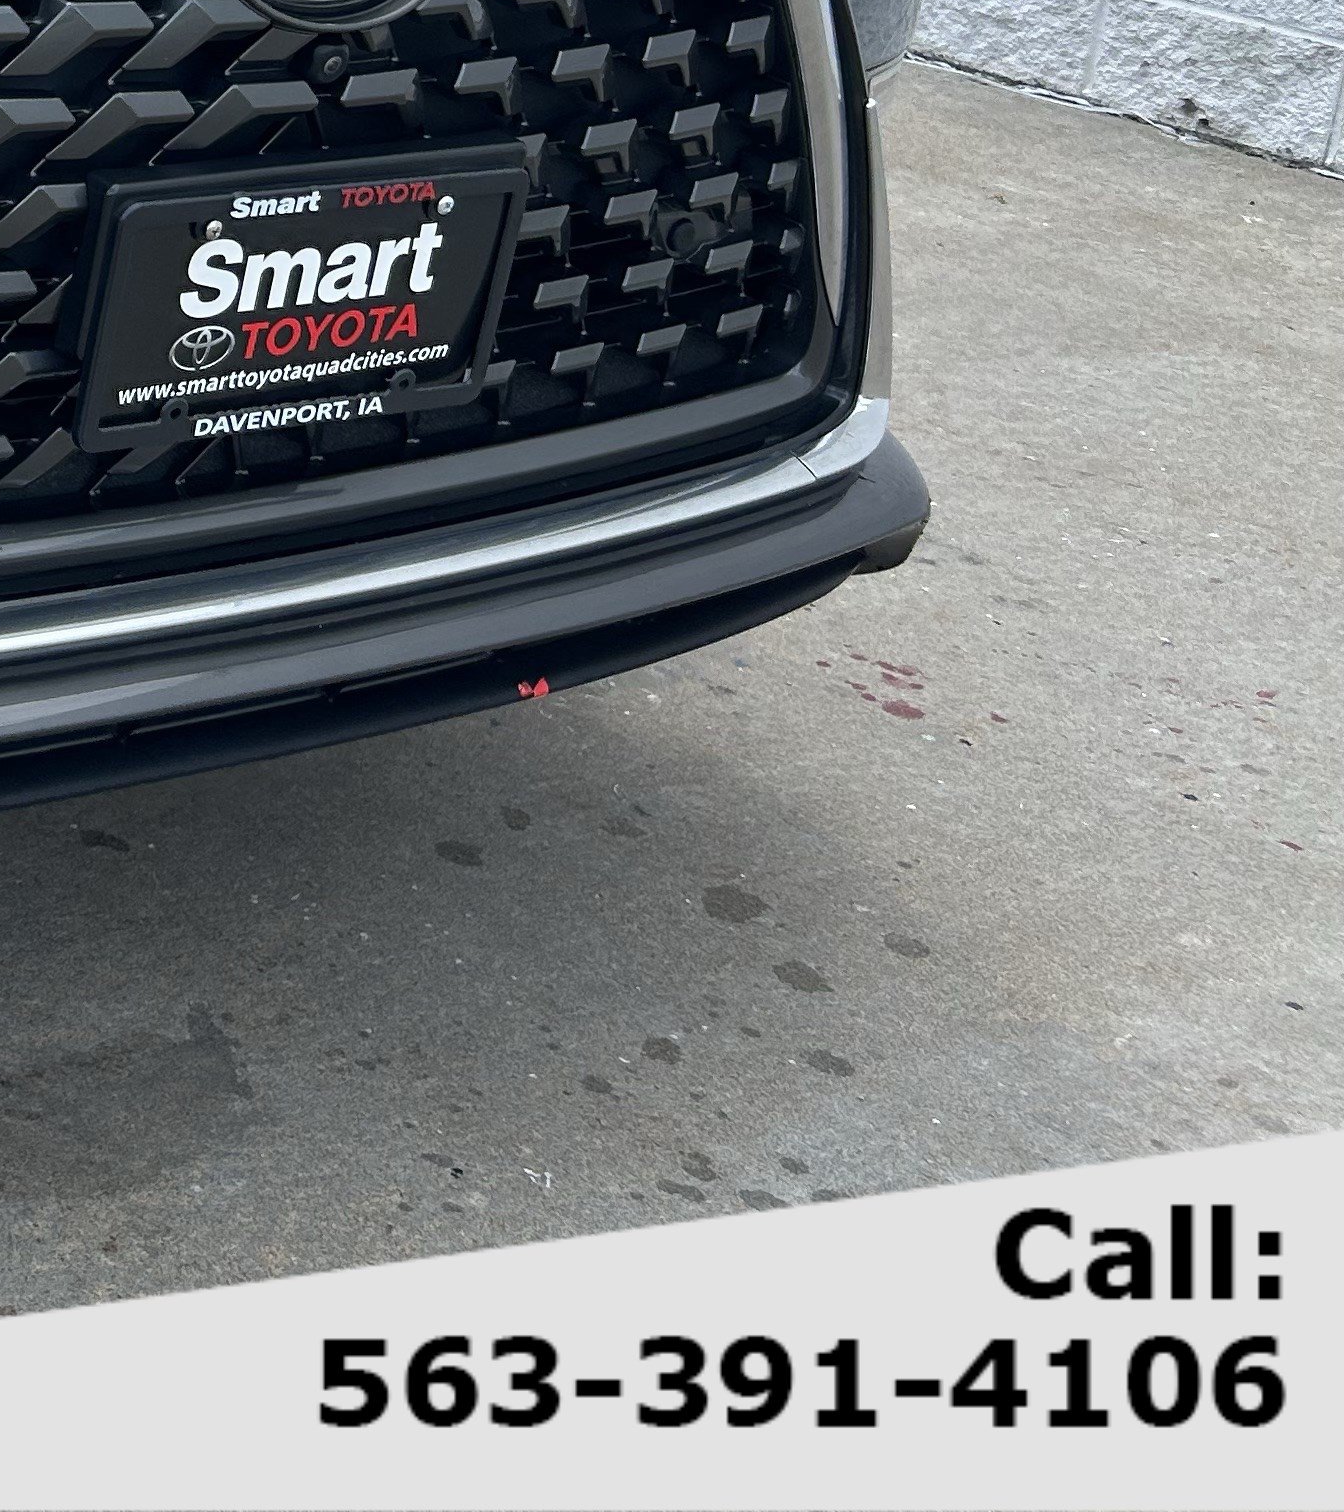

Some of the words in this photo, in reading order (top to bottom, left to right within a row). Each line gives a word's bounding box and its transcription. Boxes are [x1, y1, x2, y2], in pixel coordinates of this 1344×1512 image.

[230, 191, 321, 218] Smart
[341, 182, 436, 208] TOYOTA
[179, 221, 443, 318] Smart
[241, 303, 419, 360] TOYOTA
[118, 343, 449, 405] www.smarttoyotaquadcities.com
[194, 398, 352, 437] DAVENPORT,
[358, 396, 384, 416] IA
